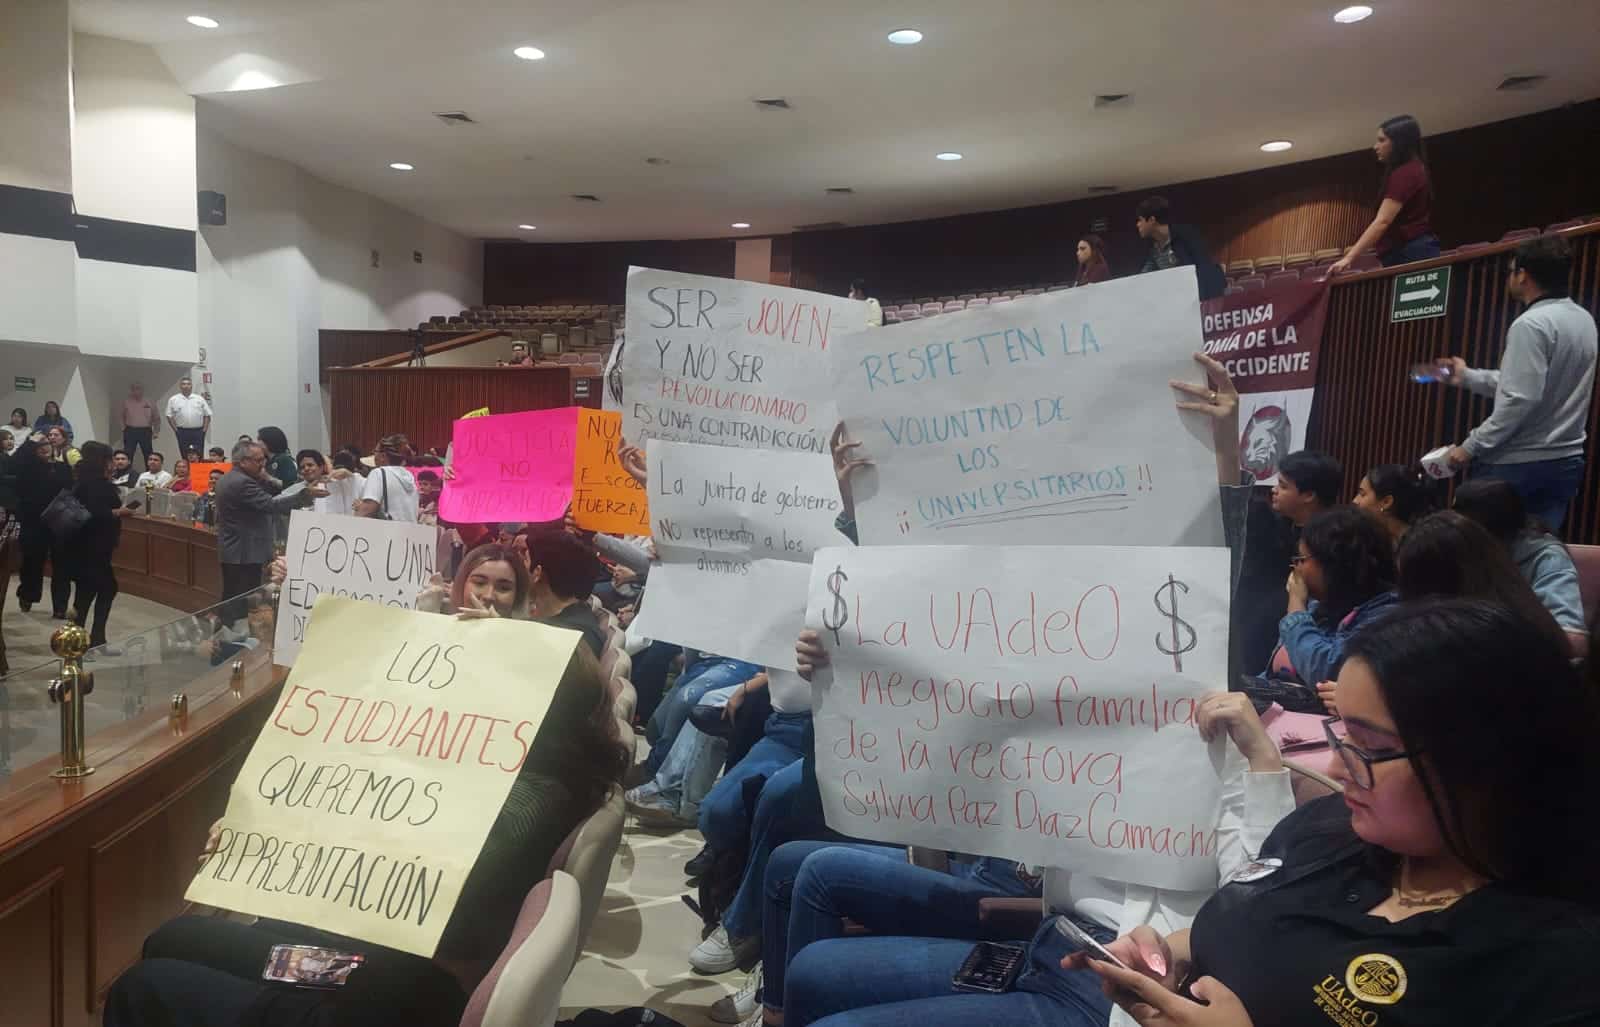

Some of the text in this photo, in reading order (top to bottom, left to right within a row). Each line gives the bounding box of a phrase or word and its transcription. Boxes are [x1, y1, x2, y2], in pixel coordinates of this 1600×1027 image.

[1405, 272, 1439, 286] RUTA DE
[647, 286, 832, 351] SER JOVEN
[1203, 303, 1274, 334] DEFENSA
[1393, 304, 1444, 319] EVACUACIÓN
[655, 338, 764, 383] Y NO SER
[860, 322, 1100, 392] RESPETEN LA
[1202, 325, 1298, 355] OMÍA DE LA
[1225, 351, 1311, 378] CCIDENTE
[659, 376, 808, 425] REVOLUCIONARIO
[881, 395, 1072, 448] VOLUNTAD DE
[586, 415, 623, 440] NU
[603, 439, 616, 465] R
[633, 402, 653, 425] ES
[659, 408, 693, 433] UNA
[700, 416, 826, 455] CONTRADICCIÓN
[500, 460, 531, 480] NO
[957, 443, 1001, 474] LOS
[660, 460, 839, 516] La junta de gobierno
[916, 464, 1128, 522] UNIVERSITARIOS
[299, 526, 434, 586] POR UNA
[658, 519, 683, 541] NO
[764, 536, 774, 551] a
[783, 528, 804, 552] los
[857, 592, 909, 647] La
[930, 583, 1121, 661] UAdeO
[385, 640, 465, 690] LOS
[859, 669, 1200, 733] negocio familia
[273, 684, 534, 773] ESTUDIANTES
[832, 719, 1124, 794] de la rectora
[257, 754, 444, 827] QUEREMOS
[842, 769, 937, 824] Sylvia
[947, 784, 1001, 827] Paz
[200, 827, 444, 927] REPRESENTACIÓN
[1321, 973, 1378, 1027] UAdeO
